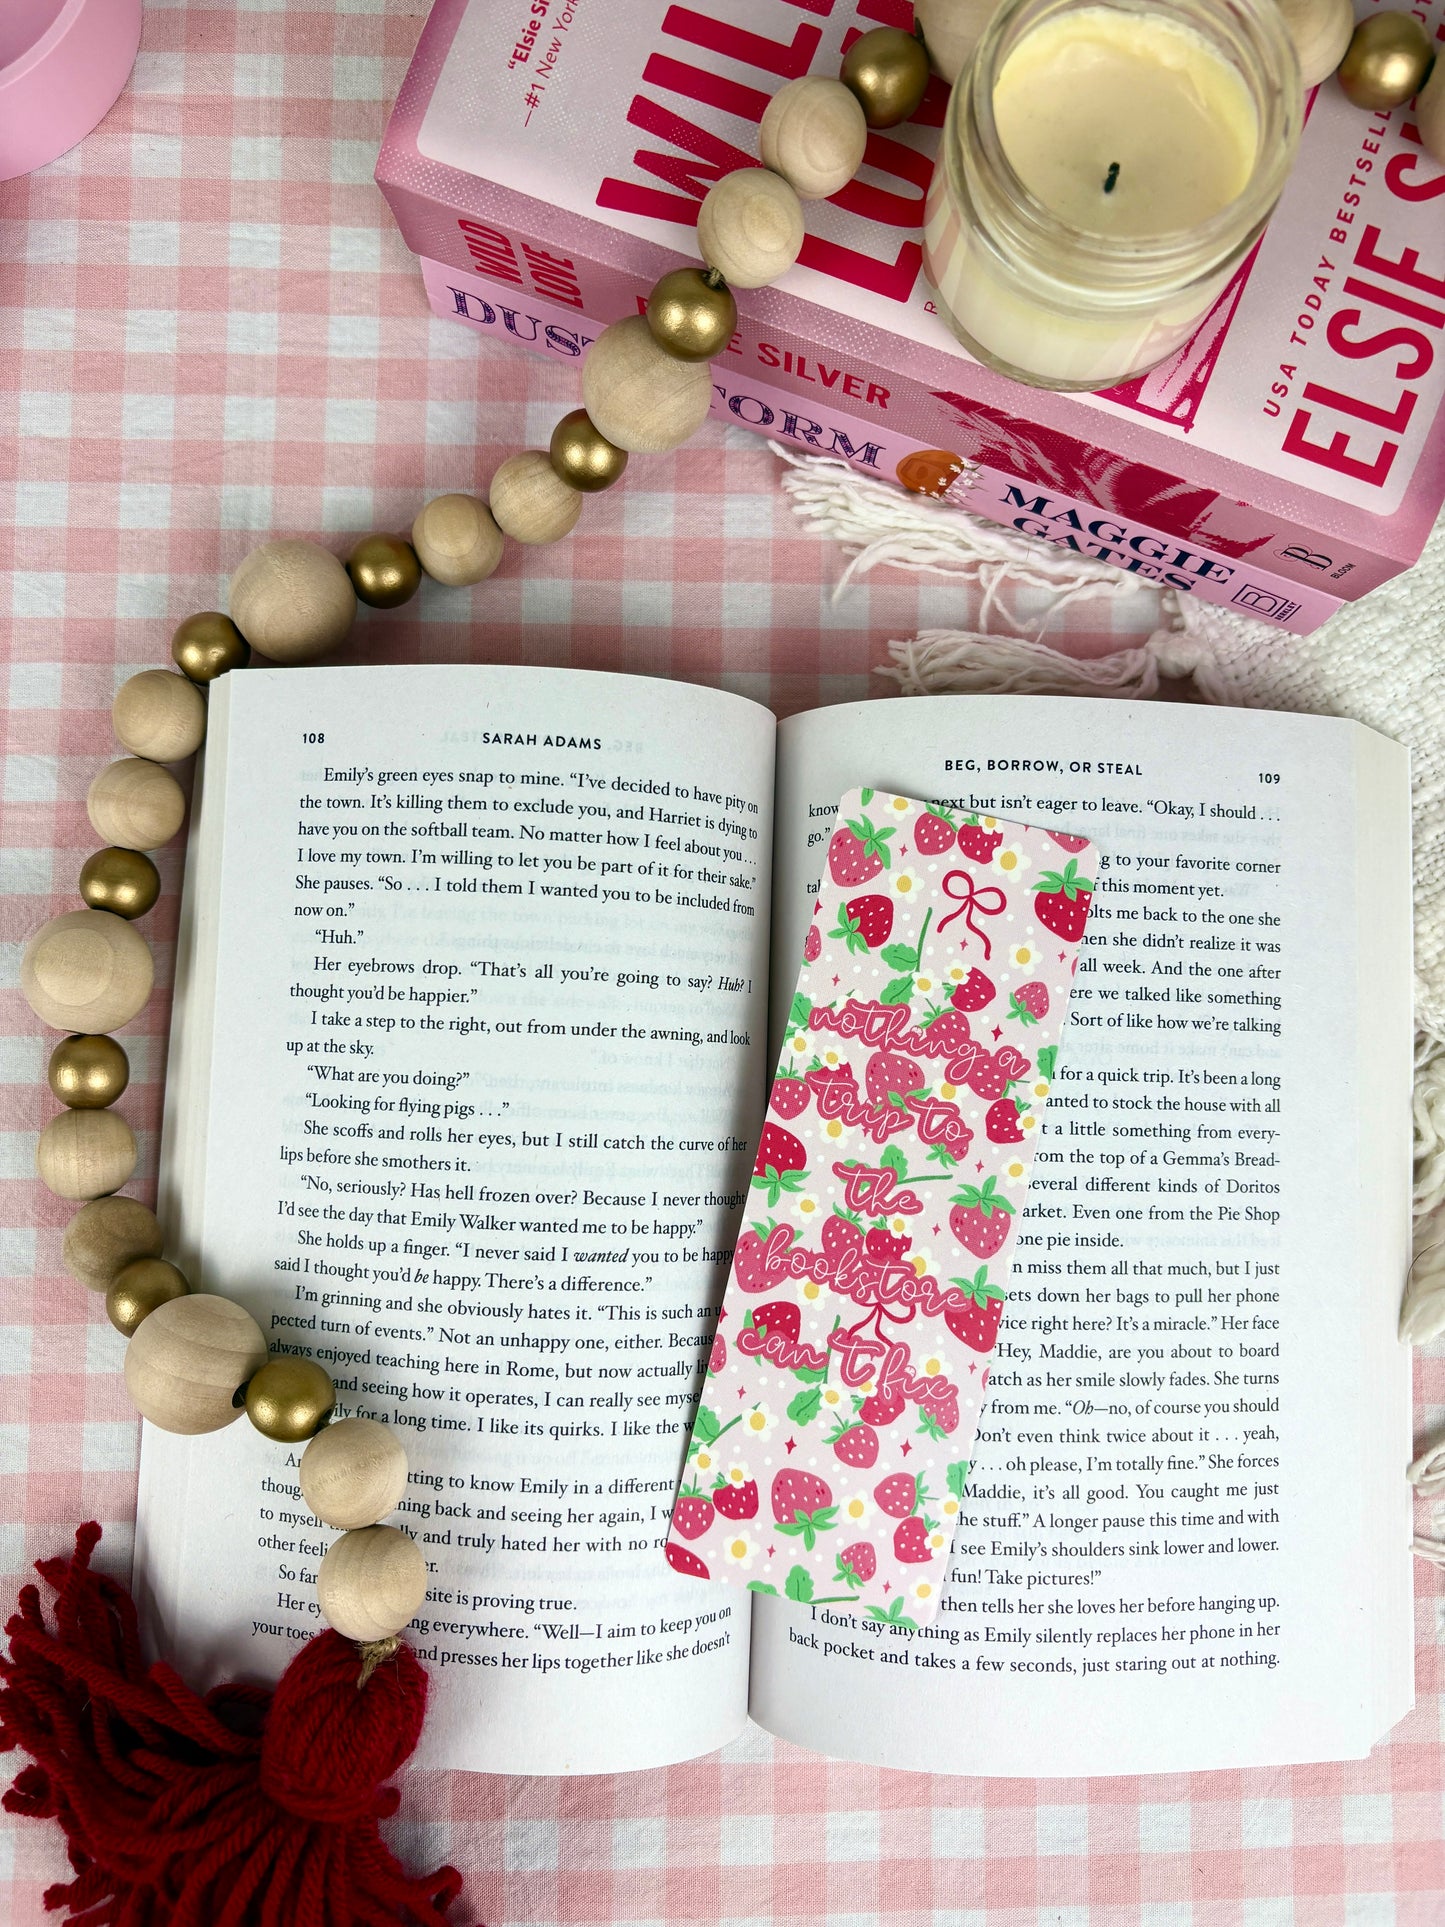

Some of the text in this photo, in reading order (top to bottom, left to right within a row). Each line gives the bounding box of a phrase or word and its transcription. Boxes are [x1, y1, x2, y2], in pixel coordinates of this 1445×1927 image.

[507, 19, 542, 69] “Elsie
[535, 36, 563, 79] New
[595, 0, 836, 227] WIL
[457, 218, 524, 285] WILD
[1262, 109, 1393, 418] USA TODAY BESTSELL
[519, 241, 585, 310] LOVE
[1281, 223, 1445, 489] ELSIE
[756, 341, 893, 410] SILVER
[997, 482, 1236, 586] MAGGIE
[1011, 516, 1198, 592] GATES
[1329, 561, 1358, 580] BLOOM
[302, 732, 325, 744] 108
[482, 731, 537, 746] SARAH
[542, 734, 602, 751] ADAMS
[944, 759, 1143, 776] BEG, BORROW, OR STEAL
[1258, 772, 1281, 785] 109
[376, 771, 418, 787] green
[422, 771, 455, 787] eyes
[458, 771, 494, 788] snap
[498, 772, 516, 786] to
[519, 770, 565, 787] mine.
[610, 775, 671, 797] decided
[674, 786, 690, 799] to
[692, 785, 723, 805] have
[724, 793, 747, 814] pity
[747, 802, 759, 815] on
[1115, 853, 1282, 874] to your favorite corner
[313, 955, 342, 972] Her
[347, 957, 415, 977] eyebrows
[422, 959, 462, 980] drop.
[534, 963, 554, 979] all
[615, 969, 660, 990] going
[665, 974, 682, 987] to
[687, 974, 713, 993] say?
[717, 975, 745, 992] Huh?
[1079, 957, 1282, 980] all week. And the one after
[289, 982, 345, 1003] thought
[387, 985, 406, 1001] be
[811, 1002, 1028, 1083] nothing a
[1070, 1011, 1104, 1027] Sort
[1106, 1012, 1125, 1028] of
[1126, 1012, 1153, 1029] like
[1156, 1013, 1189, 1030] how
[1232, 1016, 1282, 1038] talking
[357, 1071, 380, 1083] are
[381, 1073, 410, 1089] you
[808, 1073, 971, 1143] trip to
[279, 1145, 471, 1172] lips before she smothers it.
[835, 1166, 920, 1214] the
[1085, 1176, 1281, 1194] different kinds of Doritos
[297, 1206, 320, 1219] see
[322, 1204, 346, 1221] the
[348, 1206, 375, 1228] day
[376, 1208, 408, 1226] that
[410, 1210, 457, 1233] Emily
[458, 1213, 517, 1232] Walker
[518, 1217, 579, 1234] wanted
[581, 1223, 607, 1235] me
[610, 1222, 628, 1235] to
[631, 1219, 650, 1235] be
[1072, 1203, 1281, 1226] Even one from the Pie Shop
[273, 1256, 301, 1272] said
[313, 1259, 370, 1283] thought
[413, 1267, 430, 1284] be
[432, 1269, 482, 1292] happy.
[763, 1226, 969, 1315] bookstore
[880, 1345, 956, 1402] fix
[961, 1482, 1026, 1503] Maddie,
[1062, 1484, 1080, 1500] all
[1086, 1483, 1129, 1505] good.
[1135, 1483, 1165, 1499] You
[1170, 1482, 1220, 1503] caught
[1226, 1485, 1248, 1497] me
[1253, 1481, 1280, 1501] just
[950, 1567, 982, 1584] fun!
[984, 1568, 1023, 1585] Take
[439, 1651, 499, 1668] presses
[500, 1651, 530, 1669] her
[531, 1652, 561, 1674] lips
[564, 1652, 634, 1675] together
[635, 1648, 664, 1666] like
[666, 1644, 690, 1662] she
[789, 1626, 820, 1650] back
[823, 1641, 876, 1661] pocket
[879, 1649, 909, 1666] and
[914, 1652, 957, 1670] takes
[975, 1655, 1006, 1672] few
[1009, 1656, 1077, 1676] seconds,
[1081, 1657, 1110, 1677] just
[1115, 1655, 1168, 1676] staring
[1171, 1657, 1197, 1670] out
[1201, 1656, 1216, 1669] at
[1220, 1650, 1280, 1670] nothing.
